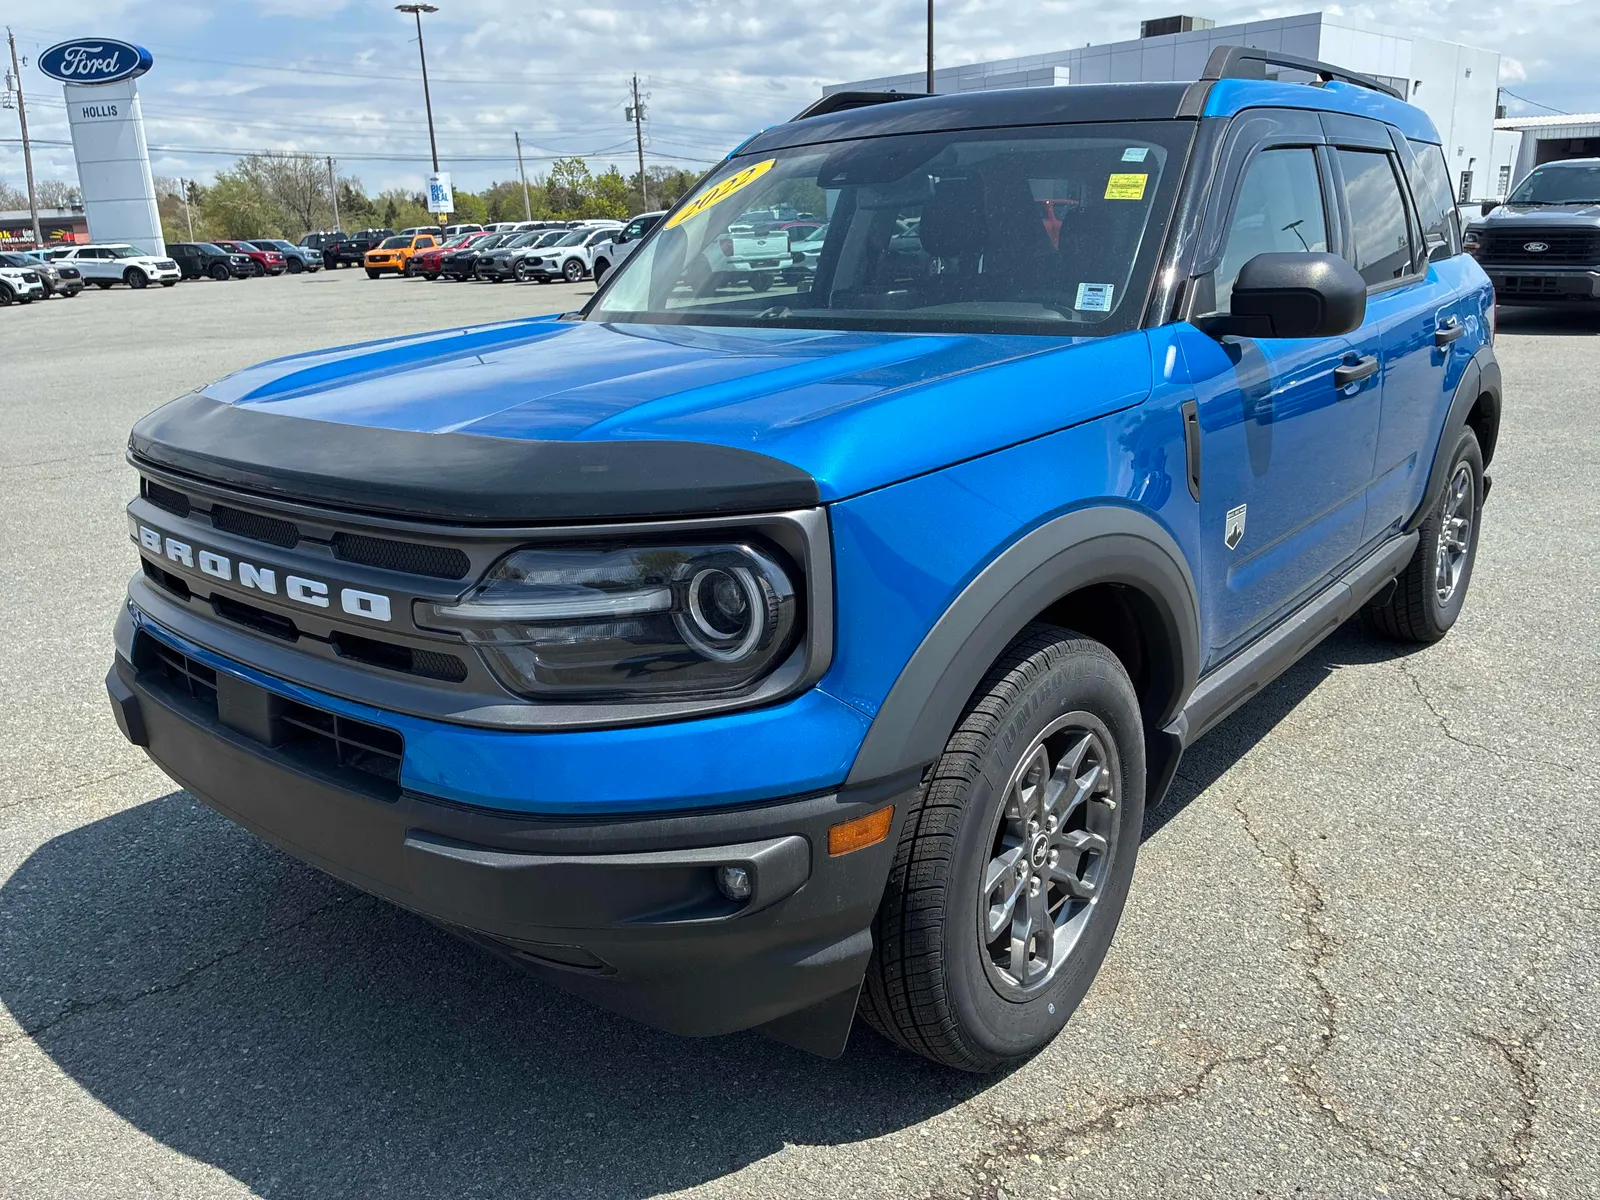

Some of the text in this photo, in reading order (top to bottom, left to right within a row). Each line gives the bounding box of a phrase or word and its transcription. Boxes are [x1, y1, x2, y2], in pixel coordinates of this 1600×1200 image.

[60, 46, 120, 76] Ford
[82, 105, 118, 118] HOLLIS
[430, 184, 444, 194] BIG
[431, 193, 449, 202] DEAL
[678, 167, 757, 223] 2022
[139, 525, 392, 622] BRONCO
[1001, 659, 1093, 753] UNIROYAL
